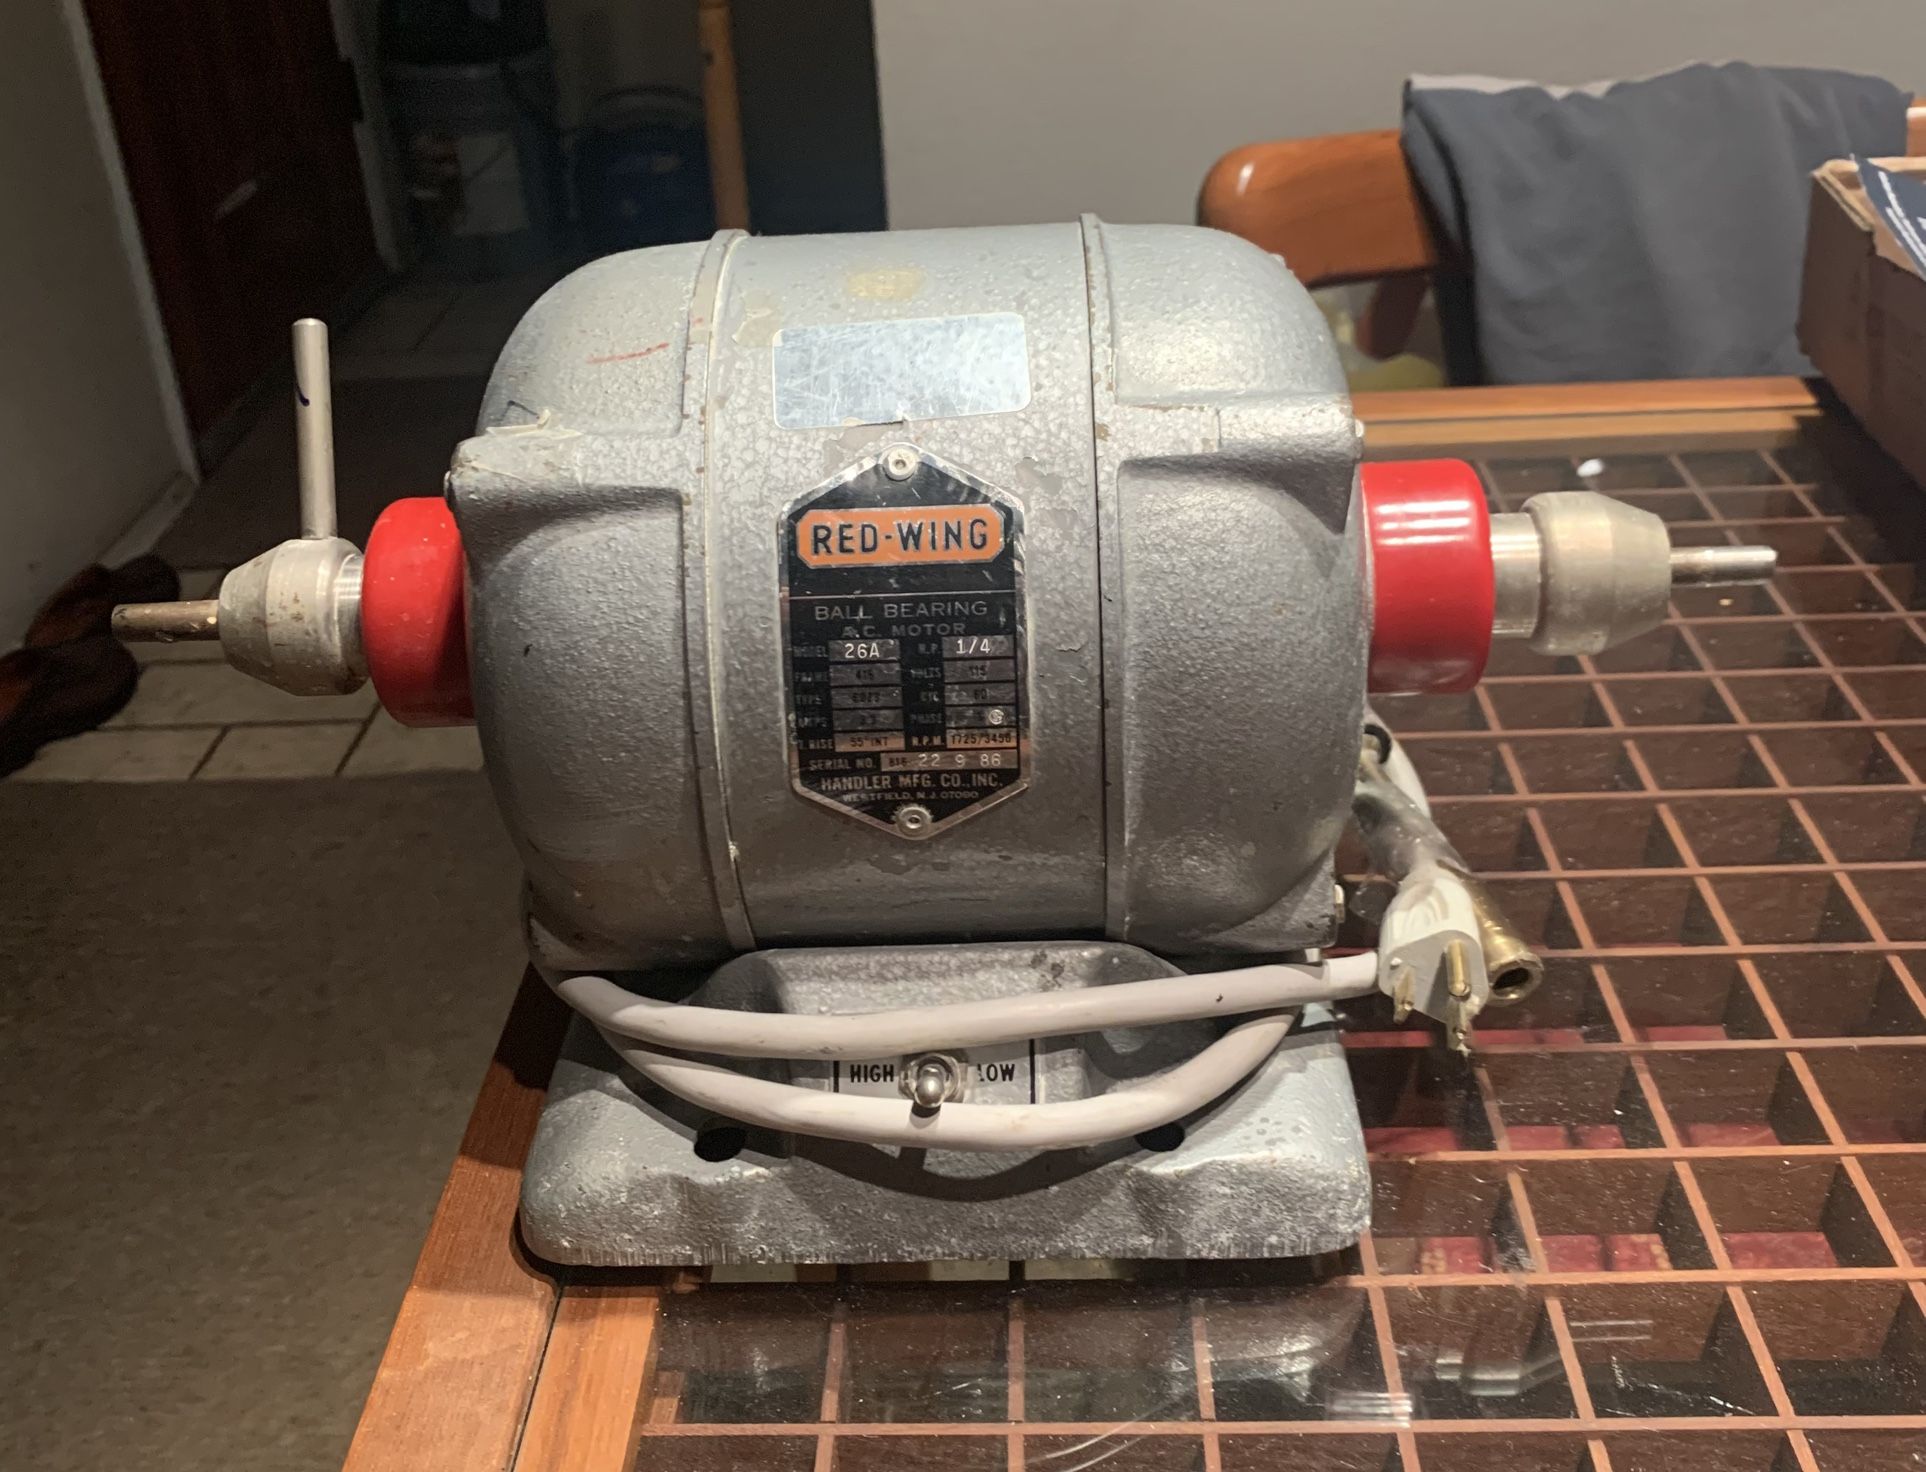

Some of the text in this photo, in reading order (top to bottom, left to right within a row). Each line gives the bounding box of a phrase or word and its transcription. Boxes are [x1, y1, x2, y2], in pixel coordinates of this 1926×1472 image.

[813, 519, 988, 556] RED-WING
[814, 601, 988, 621] BALL BEARING
[891, 623, 966, 637] MOTOR
[844, 643, 880, 659] 26A
[956, 639, 990, 655] 1/4
[809, 758, 851, 771] SERIAL
[856, 757, 877, 769] NO.
[918, 753, 940, 767] 22
[955, 754, 965, 768] 9
[980, 753, 1001, 767] 86
[821, 775, 892, 791] HANDLER
[899, 773, 936, 788] MFG.
[850, 1064, 895, 1083] HIGH
